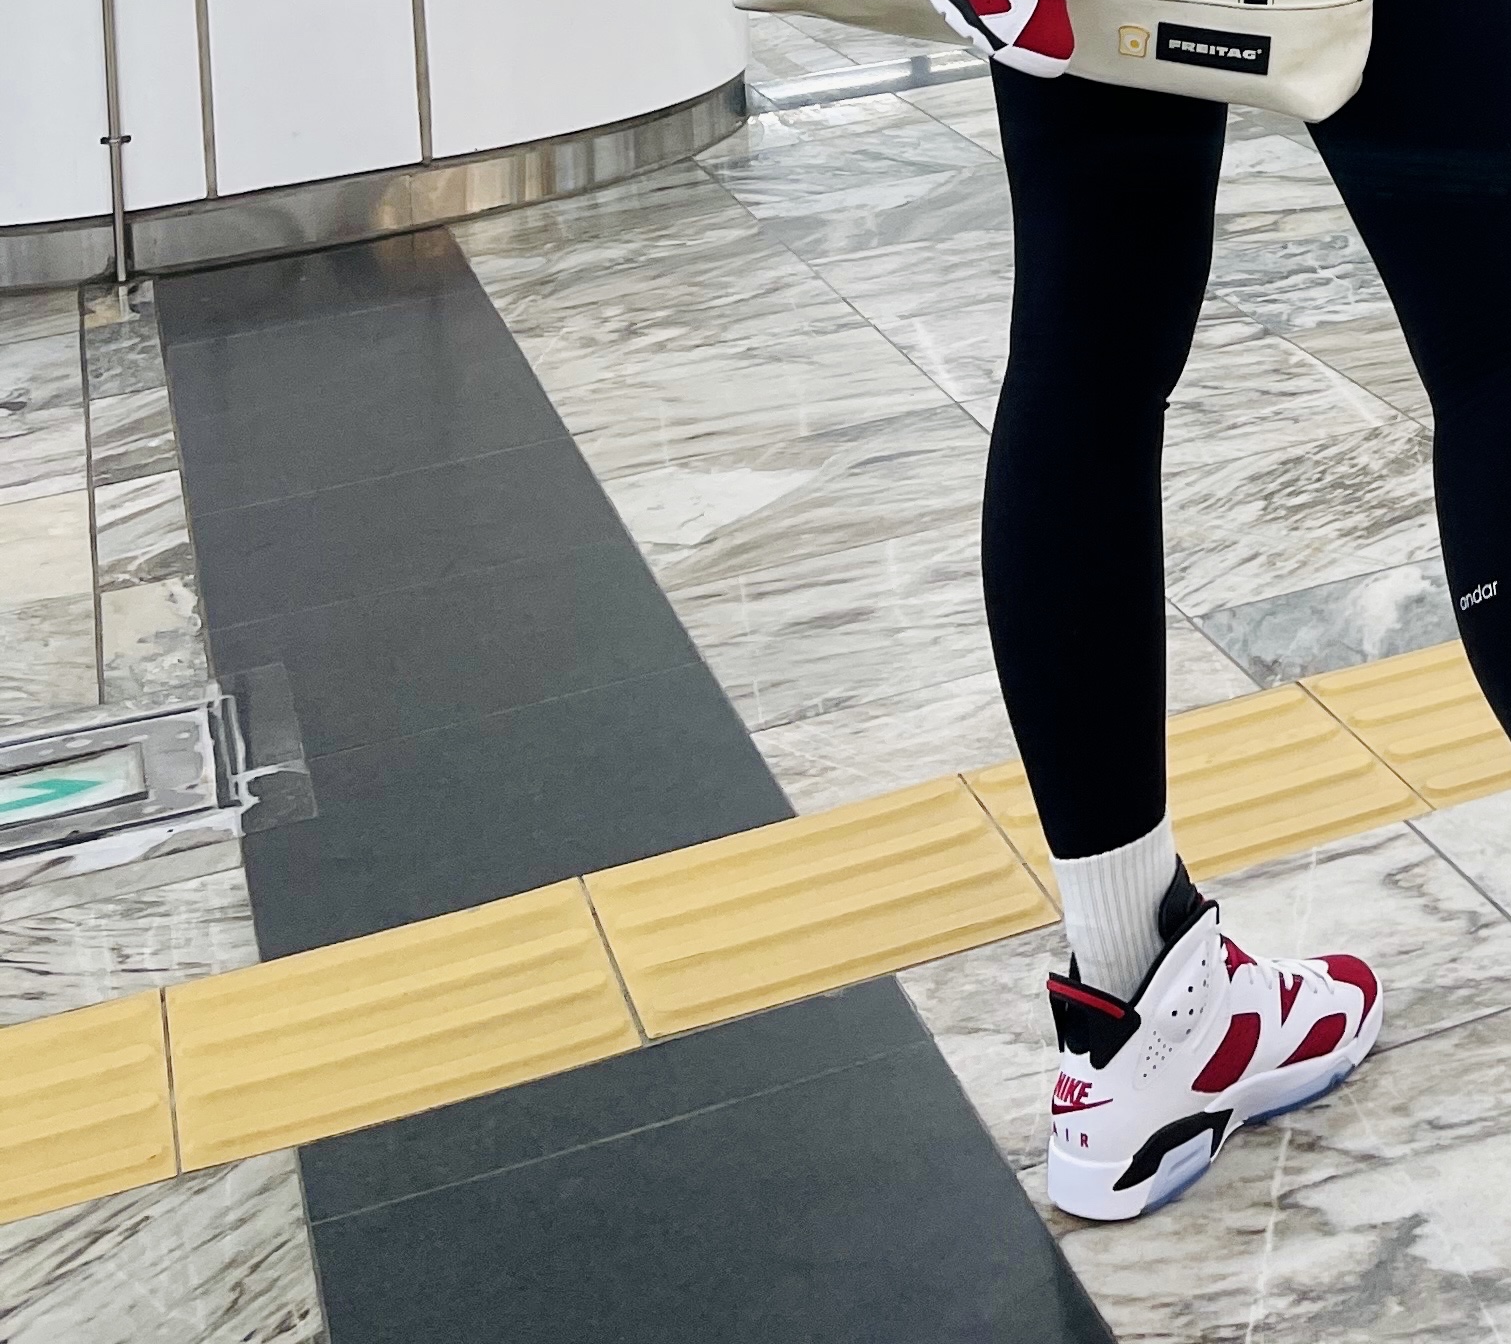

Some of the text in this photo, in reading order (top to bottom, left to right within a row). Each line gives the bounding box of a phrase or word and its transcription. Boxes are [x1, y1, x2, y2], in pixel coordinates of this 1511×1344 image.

[1168, 39, 1258, 60] FREITAG
[1459, 580, 1498, 611] andar
[1053, 1070, 1093, 1107] NIKE
